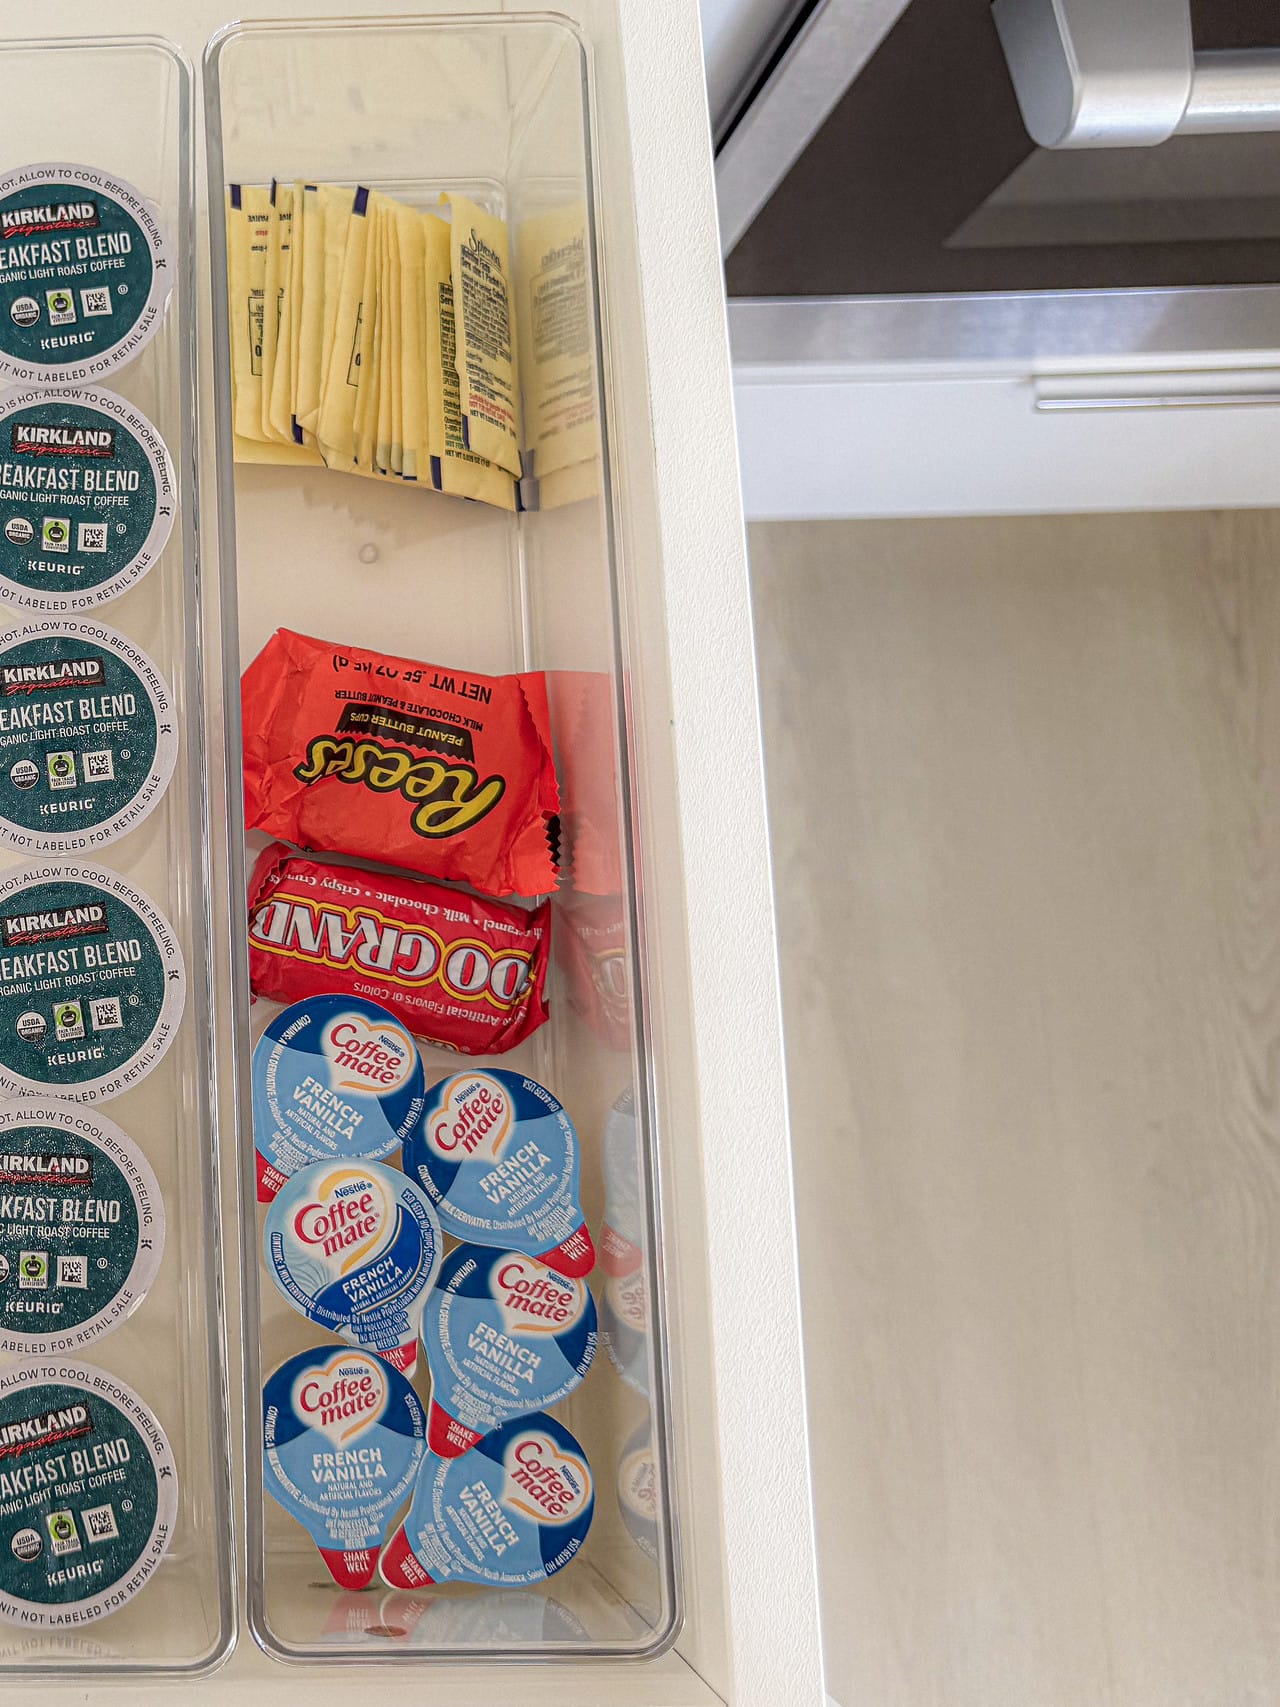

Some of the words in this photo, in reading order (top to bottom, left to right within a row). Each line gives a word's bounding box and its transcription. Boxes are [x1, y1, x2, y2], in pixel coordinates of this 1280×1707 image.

[1, 201, 95, 229] KIRKLAND
[17, 169, 54, 182] ALLOW
[74, 170, 104, 185] COOL
[103, 180, 139, 209] BEFORE
[135, 207, 163, 249] PEELING.
[75, 232, 132, 259] BLEND
[28, 268, 55, 280] LIGHT
[57, 263, 88, 276] ROAST
[90, 257, 125, 271] COFFEE
[11, 365, 33, 379] NOT
[37, 368, 87, 381] LABELED
[89, 358, 111, 374] FOR
[111, 332, 143, 362] RETAIL
[138, 306, 158, 332] SALE
[40, 331, 93, 348] KEURIG
[15, 427, 112, 447] KIRKLAND
[83, 469, 140, 493] BLEND
[30, 492, 57, 502] LIGHT
[60, 493, 91, 504] ROAST
[94, 495, 129, 506] COFFEE
[28, 562, 80, 574] KEURIG
[3, 658, 100, 685] KIRKLAND
[430, 674, 455, 693] WT
[335, 690, 367, 700] BUTTER
[370, 693, 398, 708] PEANUT
[458, 678, 492, 704] NET
[78, 693, 136, 721] BLEND
[350, 712, 369, 722] CUPS
[407, 705, 461, 723] CHOCOLATE
[29, 729, 56, 741] LIGHT
[59, 724, 90, 737] ROAST
[93, 720, 128, 733] COFFEE
[371, 714, 415, 732] BUTTER
[464, 717, 483, 732] MILK
[416, 728, 464, 746] PEANUT
[15, 765, 32, 774] USDA
[298, 737, 504, 836] Reese's
[39, 798, 93, 814] KEURIG
[321, 879, 360, 897] Crispy
[376, 893, 439, 914] Chocolate
[443, 908, 470, 922] Milk
[5, 903, 104, 934] KIRKLAND
[254, 902, 438, 978] GRAND
[83, 938, 142, 969] BLEND
[34, 978, 62, 991] LIGHT
[64, 972, 96, 987] ROAST
[98, 966, 135, 981] COFFEE
[353, 983, 388, 1000] Colors
[389, 992, 402, 1002] or
[406, 995, 444, 1015] Flavors
[447, 1005, 497, 1026] Artificial
[47, 1048, 102, 1066] KEURIG
[330, 1024, 401, 1069] Coffee
[334, 1051, 395, 1084] mate
[293, 1086, 355, 1140] VANILLA
[302, 1077, 363, 1126] FRENCH
[435, 1087, 491, 1152] Coffee
[461, 1097, 503, 1153] mate
[478, 1141, 540, 1193] FRENCH
[486, 1154, 551, 1205] VANILLA
[335, 1182, 367, 1199] Nestlé
[61, 1198, 120, 1224] BLEND
[294, 1193, 373, 1244] Coffee
[6, 1224, 34, 1235] LIGHT
[37, 1225, 69, 1236] ROAST
[72, 1226, 109, 1238] COFFEE
[322, 1216, 376, 1256] mate
[559, 1232, 584, 1255] SHAKE
[567, 1243, 589, 1262] WELL
[342, 1256, 394, 1294] FRENCH
[348, 1267, 403, 1303] VANILLA
[498, 1264, 573, 1306] Coffee
[5, 1301, 60, 1314] KEURIG
[505, 1292, 569, 1322] mate
[476, 1322, 542, 1366] FRENCH
[467, 1334, 534, 1384] VANILLA
[300, 1376, 371, 1412] Coffee
[321, 1393, 376, 1425] mate
[447, 1431, 467, 1449] WELL
[449, 1421, 475, 1441] SHAKE
[69, 1437, 132, 1476] BLEND
[312, 1448, 382, 1468] FRENCH
[311, 1464, 386, 1484] VANILLA
[515, 1440, 574, 1504] Coffee
[23, 1489, 53, 1507] LIGHT
[54, 1479, 87, 1498] ROAST
[88, 1468, 126, 1488] COFFEE
[511, 1467, 563, 1515] mate
[459, 1486, 506, 1556] VANILLA
[471, 1481, 519, 1546] FRENCH
[343, 1551, 369, 1562] SHAKE
[346, 1560, 368, 1573] WELL
[406, 1554, 426, 1581] SHAKE
[545, 1565, 556, 1574] OH
[568, 1538, 581, 1552] USA
[20, 1609, 44, 1623] NOT
[48, 1604, 101, 1623] LABELED
[102, 1590, 125, 1610] FOR
[123, 1555, 156, 1593] RETAIL
[149, 1523, 167, 1555] SALE
[46, 1560, 102, 1586] KEURIG
[400, 1562, 418, 1584] WELL
